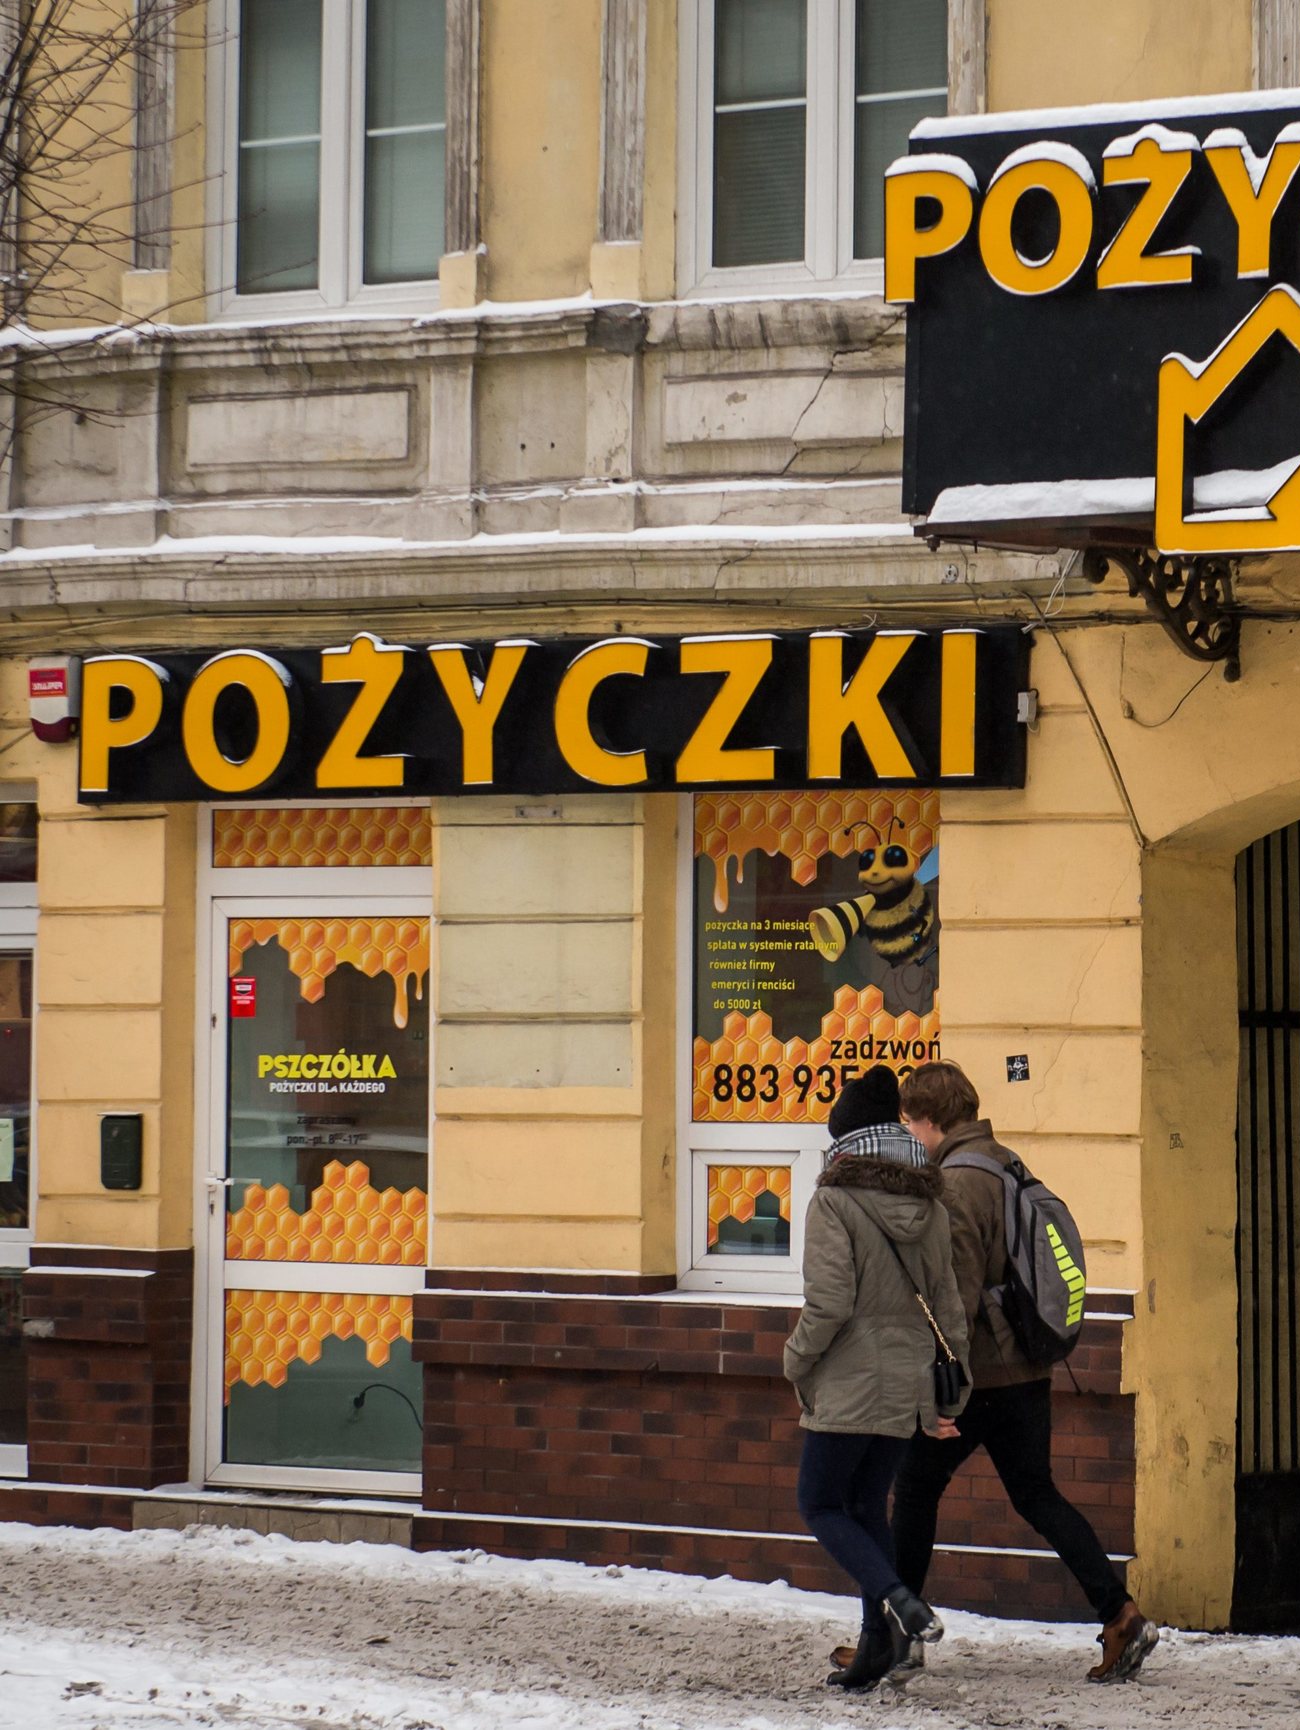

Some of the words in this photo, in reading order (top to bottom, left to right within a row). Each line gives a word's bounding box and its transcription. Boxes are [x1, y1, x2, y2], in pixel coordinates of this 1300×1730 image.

[79, 632, 977, 792] POŻYCZKI
[705, 919, 748, 932] pożyczka
[751, 921, 762, 930] na
[764, 920, 771, 930] 3
[773, 919, 816, 933] miesiące
[707, 940, 737, 952] spłata
[739, 942, 747, 950] w
[749, 940, 792, 952] systemie
[709, 959, 747, 970] również
[749, 959, 776, 973] firmy
[711, 979, 750, 991] emeryci
[757, 978, 796, 990] renciści
[713, 999, 725, 1010] do
[727, 999, 751, 1010] 5000
[752, 999, 762, 1010] zł
[830, 1032, 941, 1060] zadzwoń
[257, 1047, 398, 1079] PSZCZÓŁKA
[269, 1080, 317, 1093] POŻYCZKI
[339, 1080, 386, 1093] KAŻDEGO
[713, 1063, 779, 1103] 883
